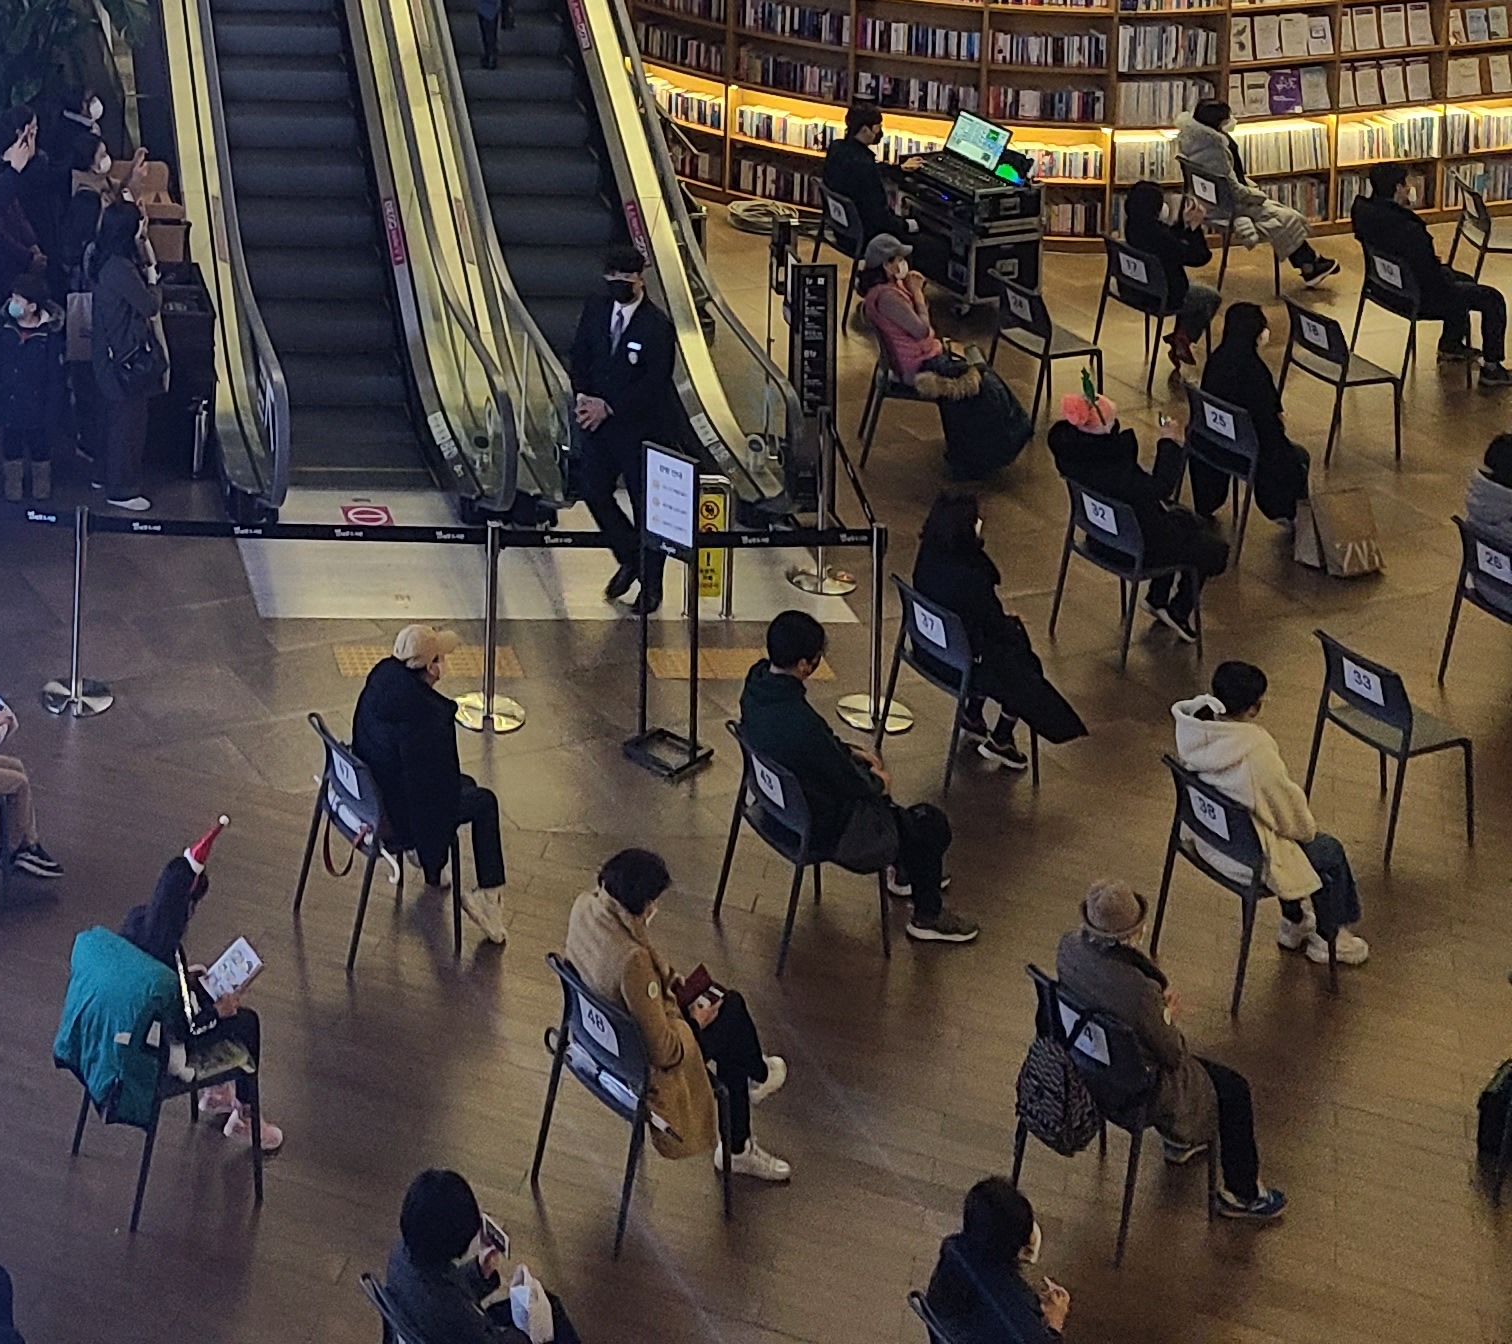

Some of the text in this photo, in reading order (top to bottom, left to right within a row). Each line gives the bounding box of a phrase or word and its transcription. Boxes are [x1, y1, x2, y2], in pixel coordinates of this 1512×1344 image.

[1125, 259, 1137, 273] 17
[1306, 321, 1319, 337] 18
[1211, 411, 1226, 427] 25
[1091, 502, 1107, 521] 32
[1485, 551, 1502, 570] 26
[921, 612, 934, 631] 37
[1353, 669, 1372, 691] 33
[760, 769, 774, 791] 43
[1197, 796, 1217, 820] 38
[588, 1008, 605, 1033] 48
